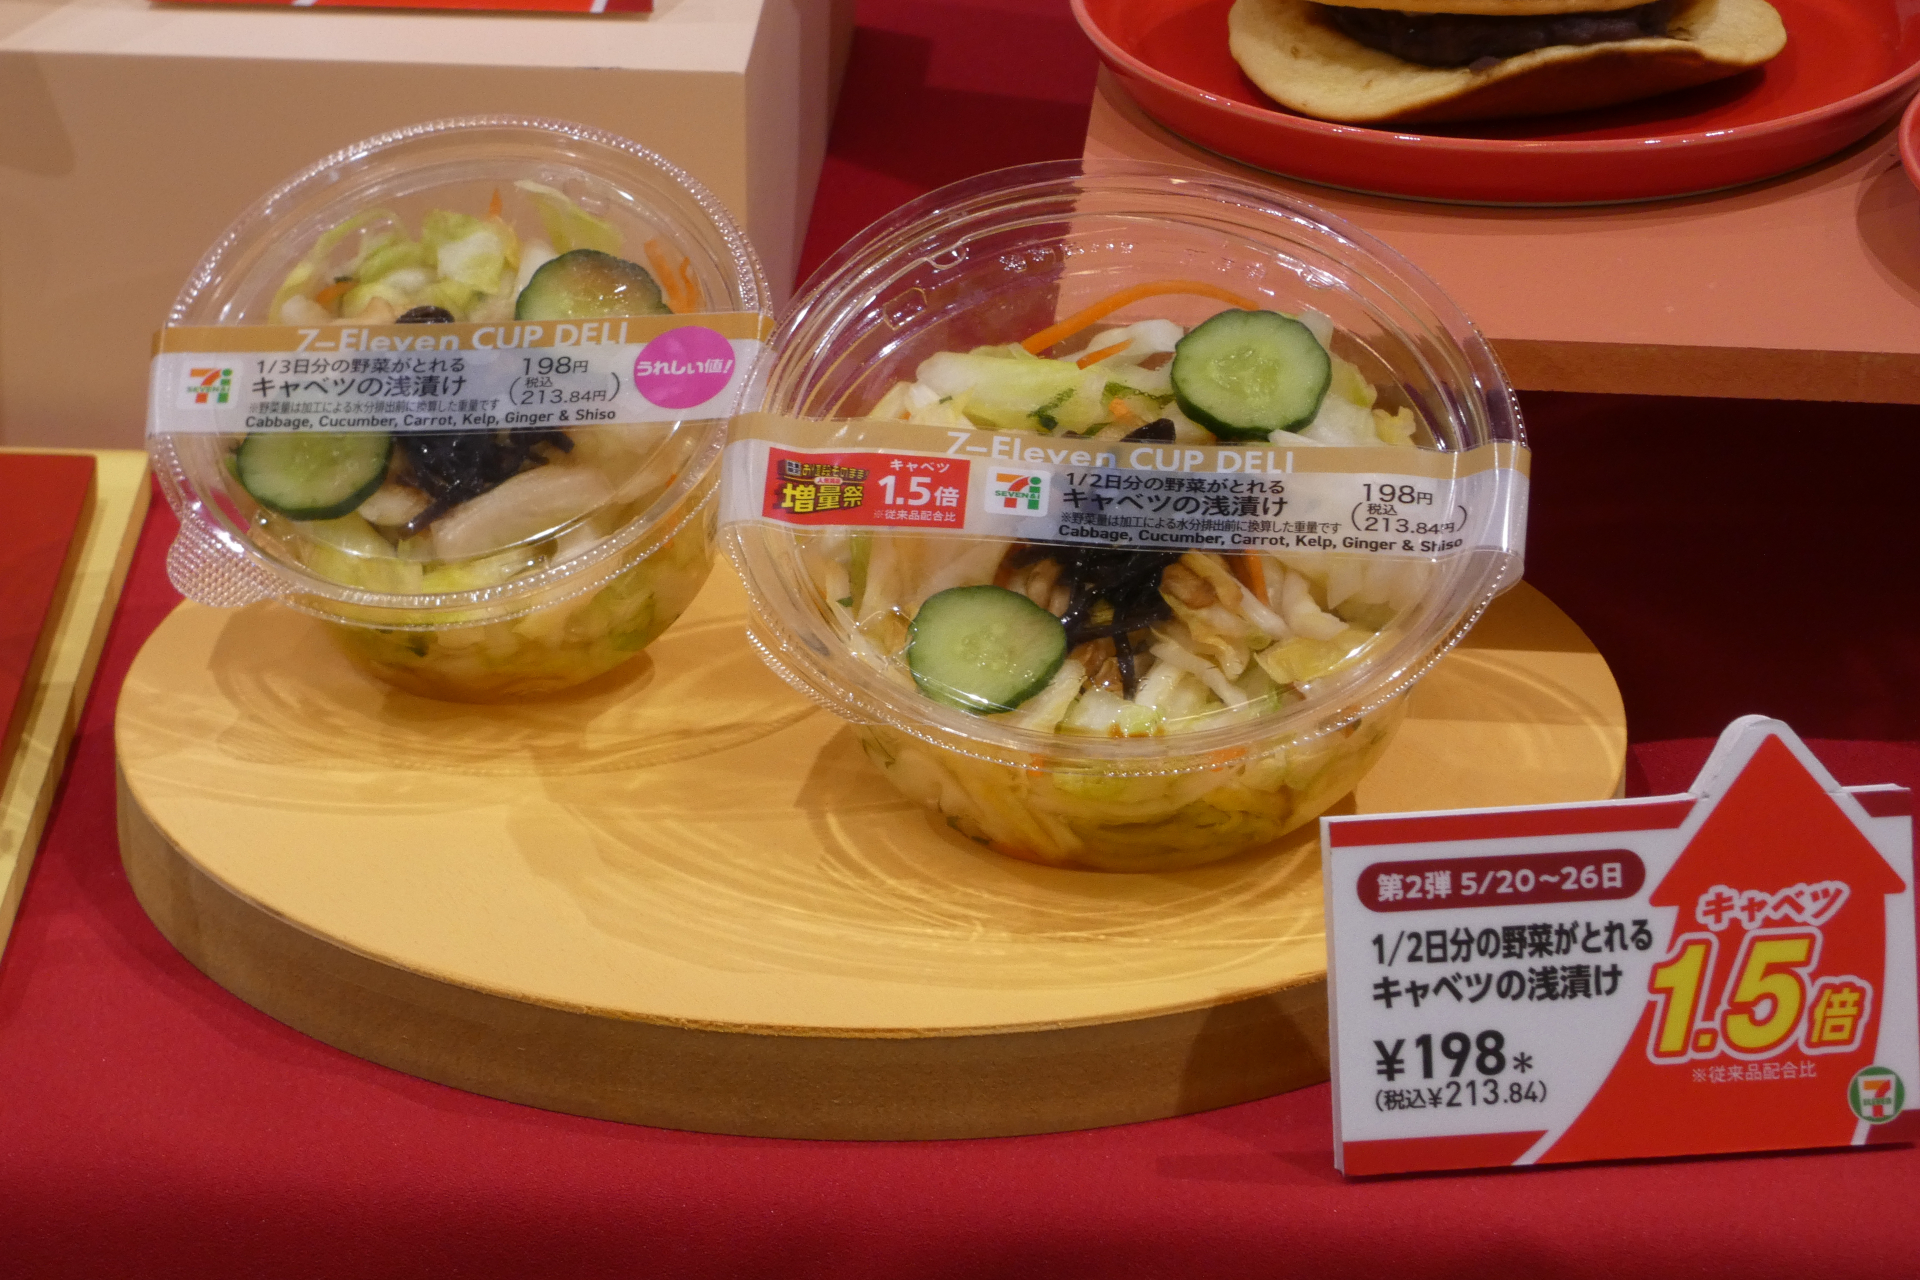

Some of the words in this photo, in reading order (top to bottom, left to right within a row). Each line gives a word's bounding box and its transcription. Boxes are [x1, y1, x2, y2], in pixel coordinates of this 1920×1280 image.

[471, 325, 544, 350] CUP
[554, 321, 629, 348] DELI
[256, 357, 465, 375] 1/3日分の野菜がとれる
[522, 356, 589, 376] 198円
[636, 358, 734, 377] うれしい値!
[252, 375, 467, 398] キャベツの浅漬け
[524, 377, 553, 388] 税込
[245, 415, 313, 429] Cabbage,
[319, 414, 398, 428] Cucumber,
[403, 413, 457, 427] Carrot,
[463, 412, 500, 427] Kelp,
[505, 410, 554, 425] Ginger
[559, 410, 570, 422] &
[575, 408, 617, 421] Shiso
[890, 458, 950, 473] キャベツ
[1129, 446, 1204, 472] CUP
[1216, 449, 1294, 474] DELI
[878, 475, 960, 508] 1.5倍
[1066, 472, 1285, 495] 1/2日分の野菜がとれる
[1363, 483, 1433, 506] 198円
[781, 482, 864, 513] 増量祭
[1063, 488, 1288, 517] キャベツの浅漬け
[1367, 503, 1398, 516] 税込
[1058, 524, 1133, 543] Cabbage,
[1138, 529, 1225, 546] Cucumber,
[1231, 532, 1290, 548] Carrot,
[1295, 534, 1337, 550] Kelp,
[1342, 536, 1397, 552] Ginger
[1401, 539, 1415, 551] &
[1420, 537, 1463, 552] Shiso
[1376, 870, 1453, 902] 第2弾
[1699, 883, 1847, 928] キャベツ
[1372, 919, 1654, 967] 1/2日分の野菜がとれる
[1372, 963, 1623, 1009] キャベツの浅漬け
[1650, 933, 1867, 1058] 1.5倍
[1691, 1060, 1817, 1084] ※従来品配合比
